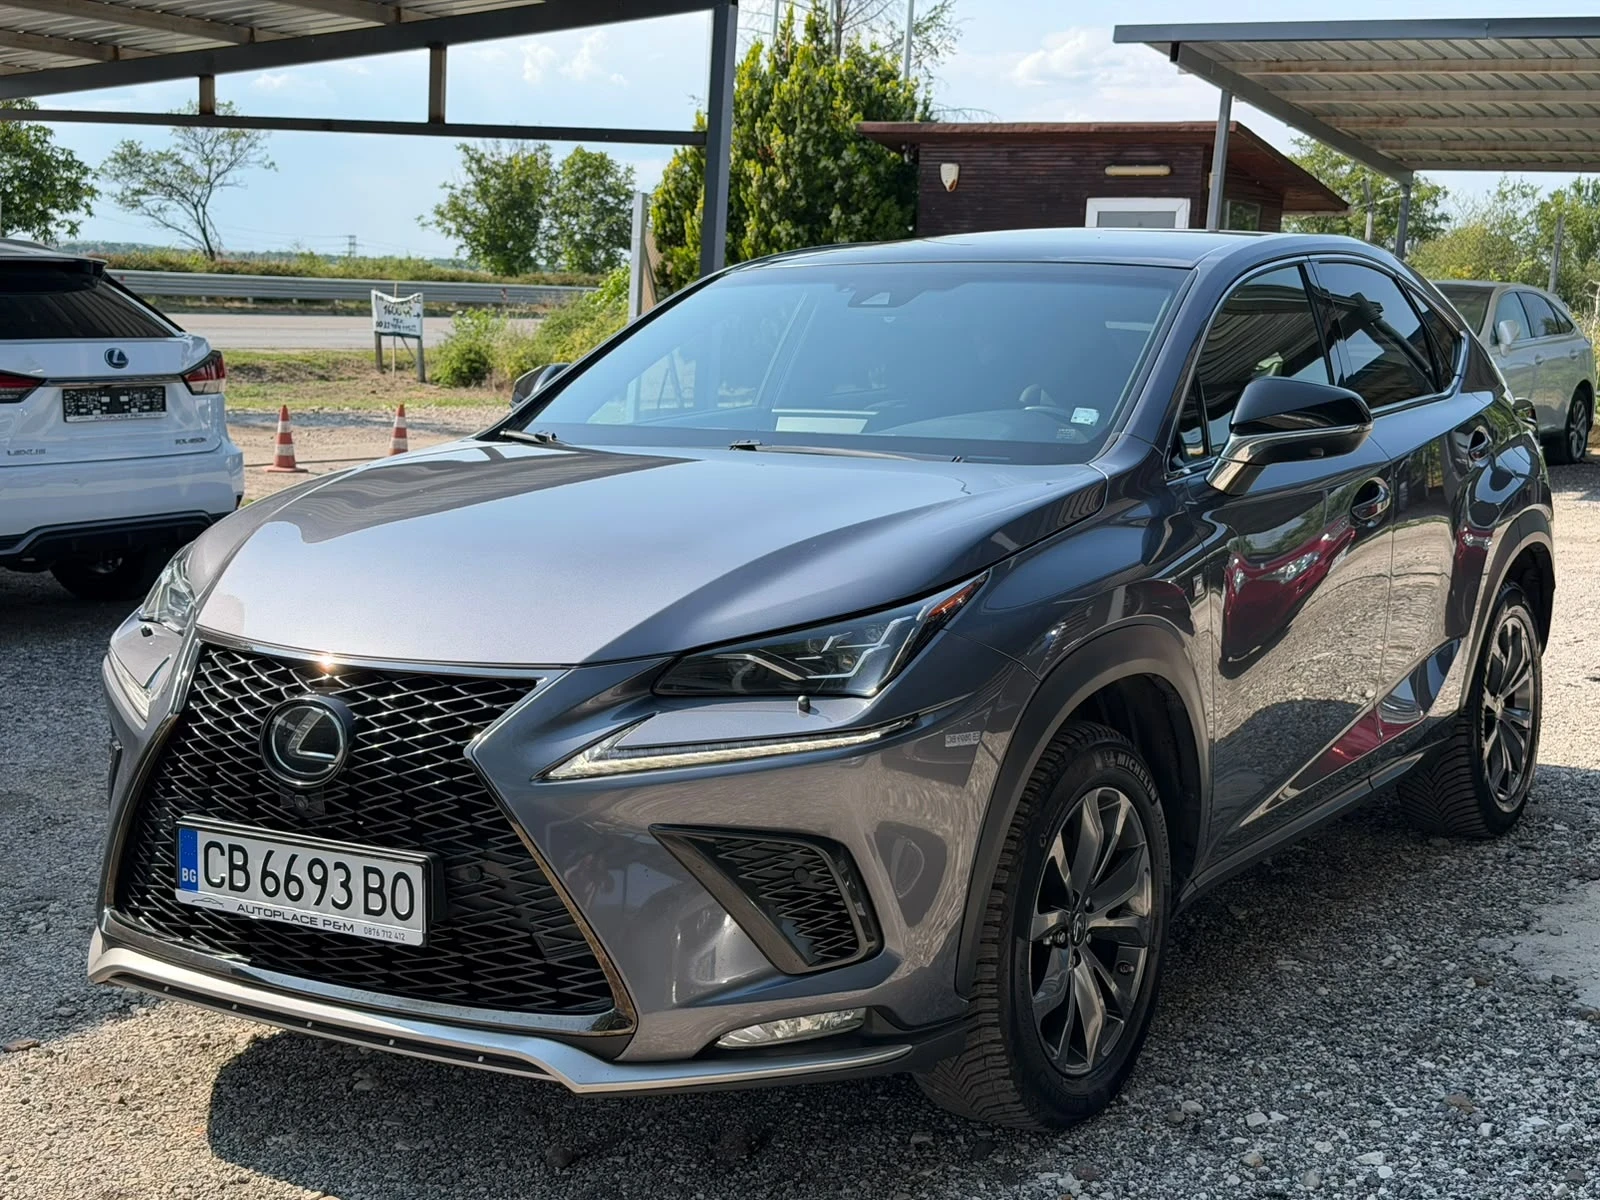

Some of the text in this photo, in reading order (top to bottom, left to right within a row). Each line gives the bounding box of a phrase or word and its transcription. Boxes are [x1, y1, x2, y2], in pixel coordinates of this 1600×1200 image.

[7, 448, 46, 456] LEXUS
[1116, 752, 1158, 802] MICHELIN
[181, 866, 197, 884] BG
[203, 840, 251, 893] CB
[260, 849, 353, 911] 6693
[236, 903, 406, 942] AUTOPLACE P&M 0876 712 412
